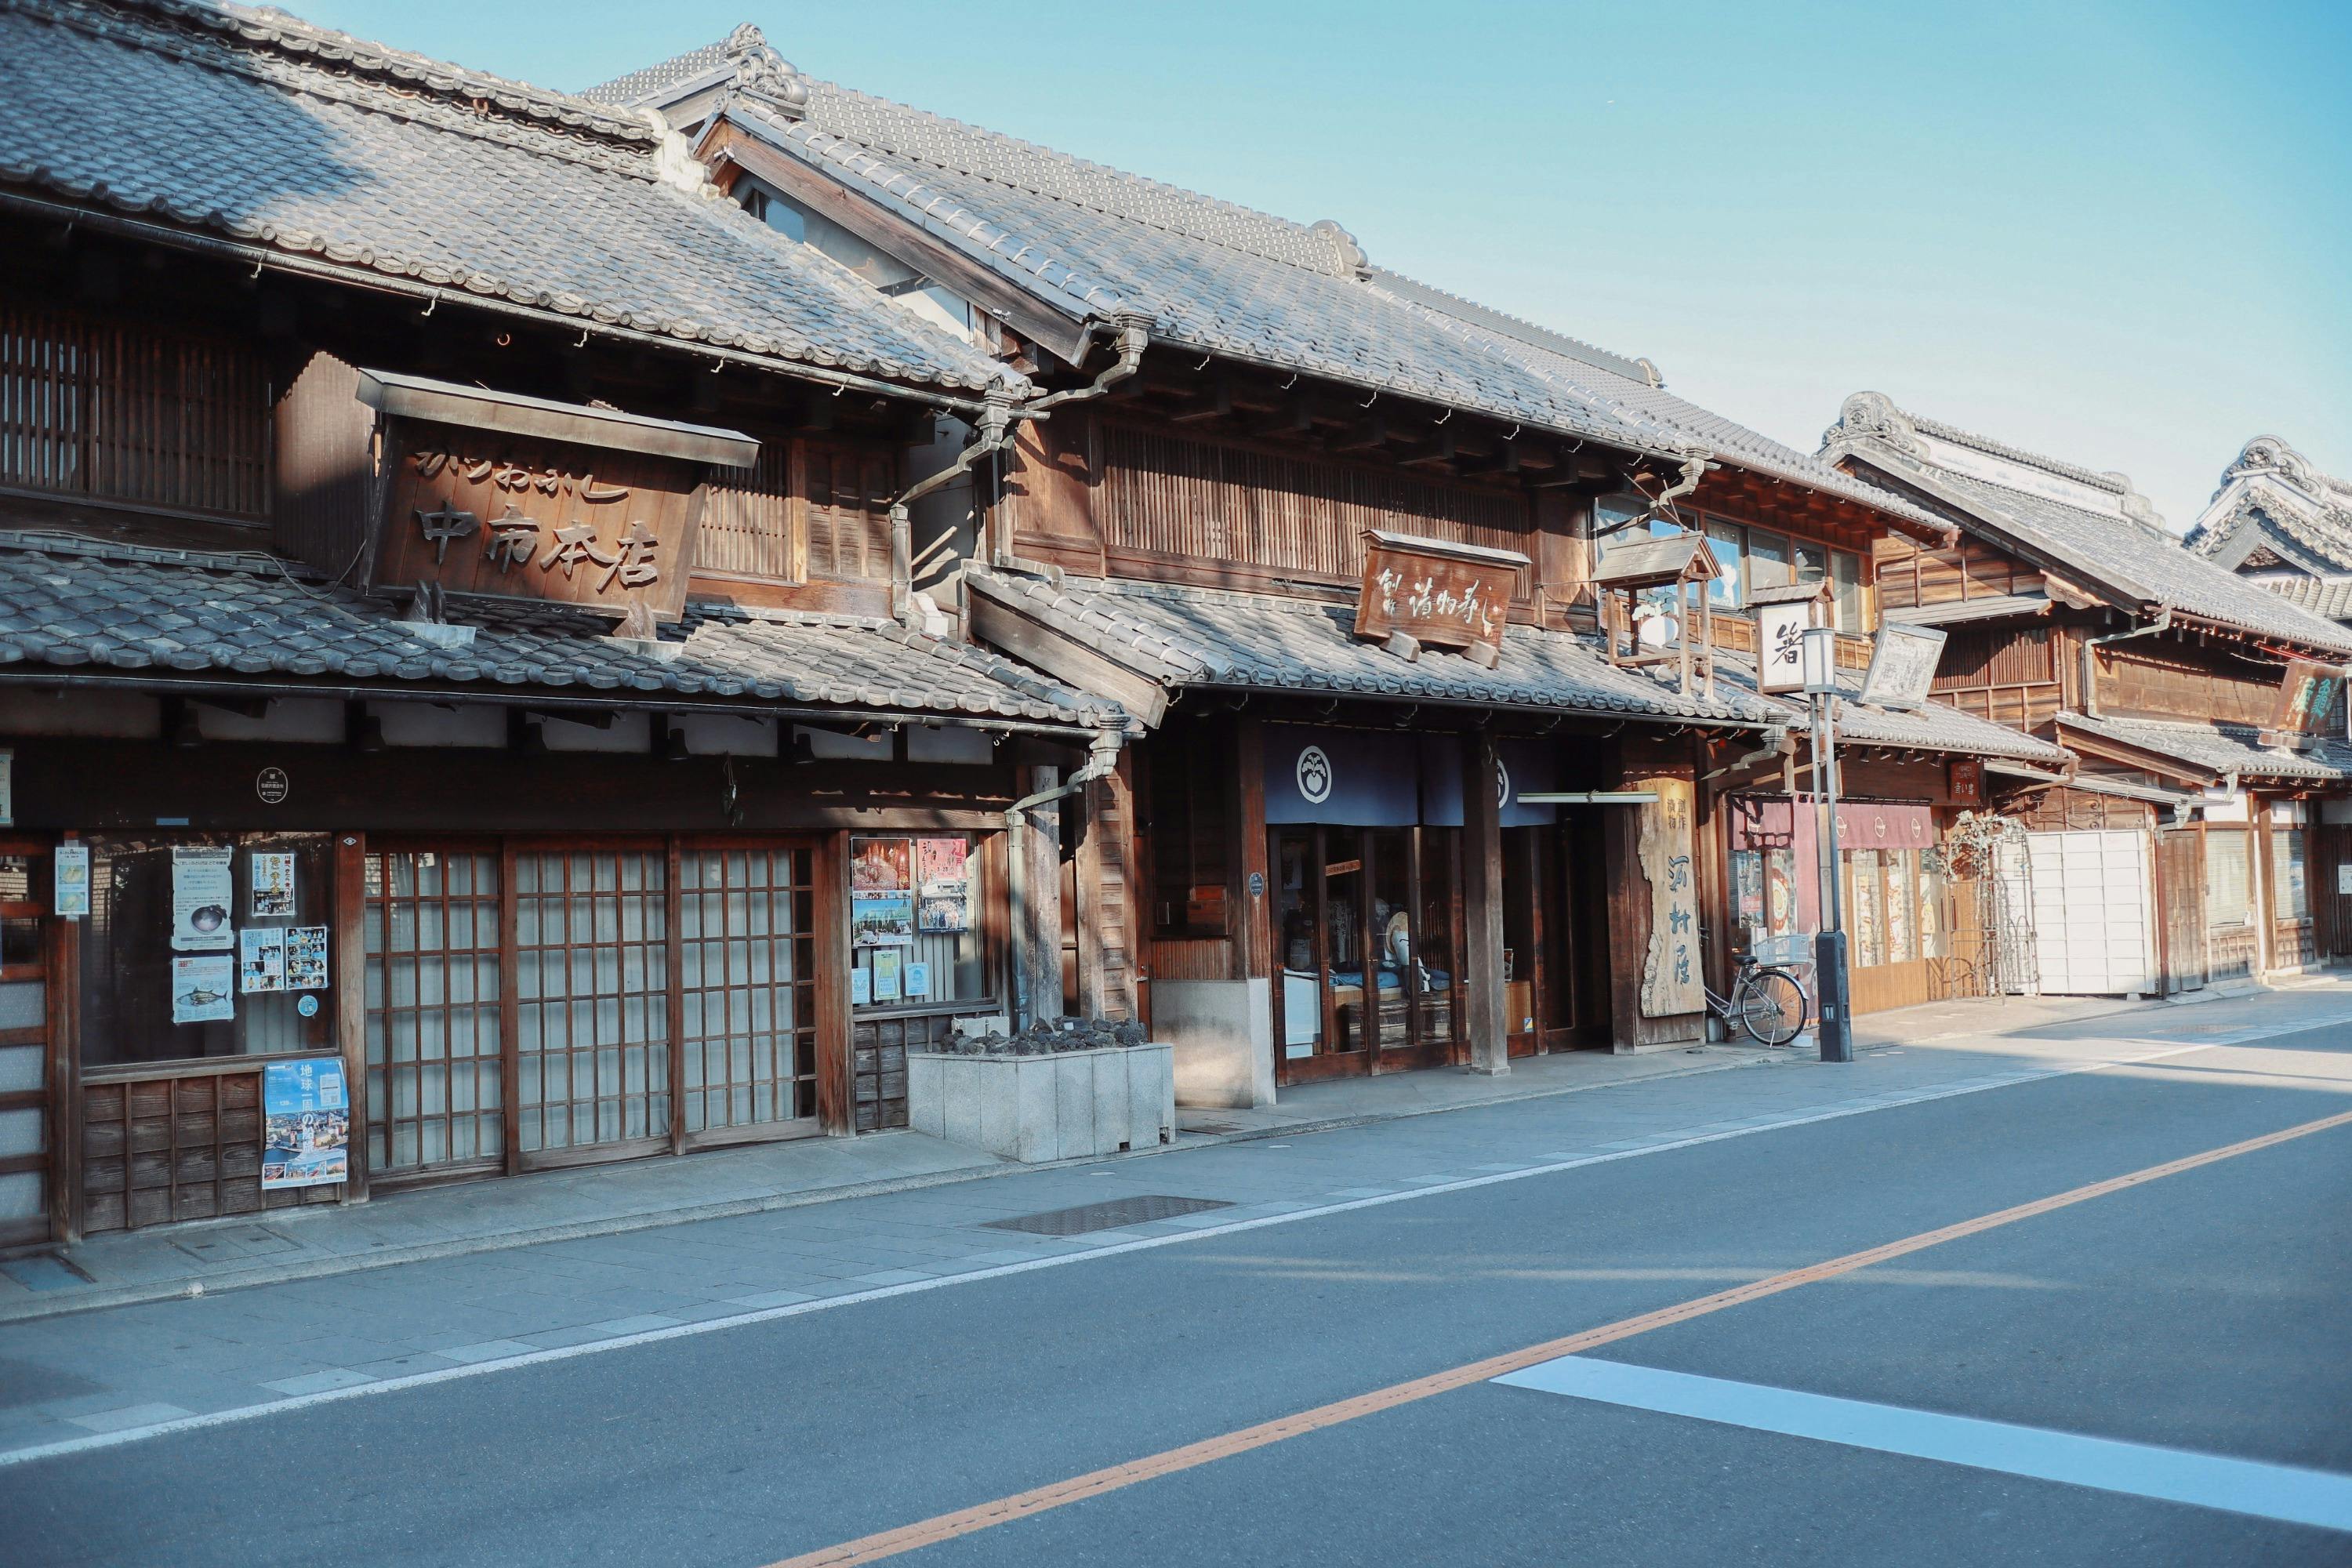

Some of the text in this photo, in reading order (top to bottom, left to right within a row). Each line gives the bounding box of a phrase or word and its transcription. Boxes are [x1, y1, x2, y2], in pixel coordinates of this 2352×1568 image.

[416, 500, 660, 593] 中市本店
[1772, 622, 1803, 666] 箸
[1667, 798, 1676, 829] 漬物
[1678, 798, 1686, 829] 創作
[300, 1065, 314, 1154] 地球一周の船旅
